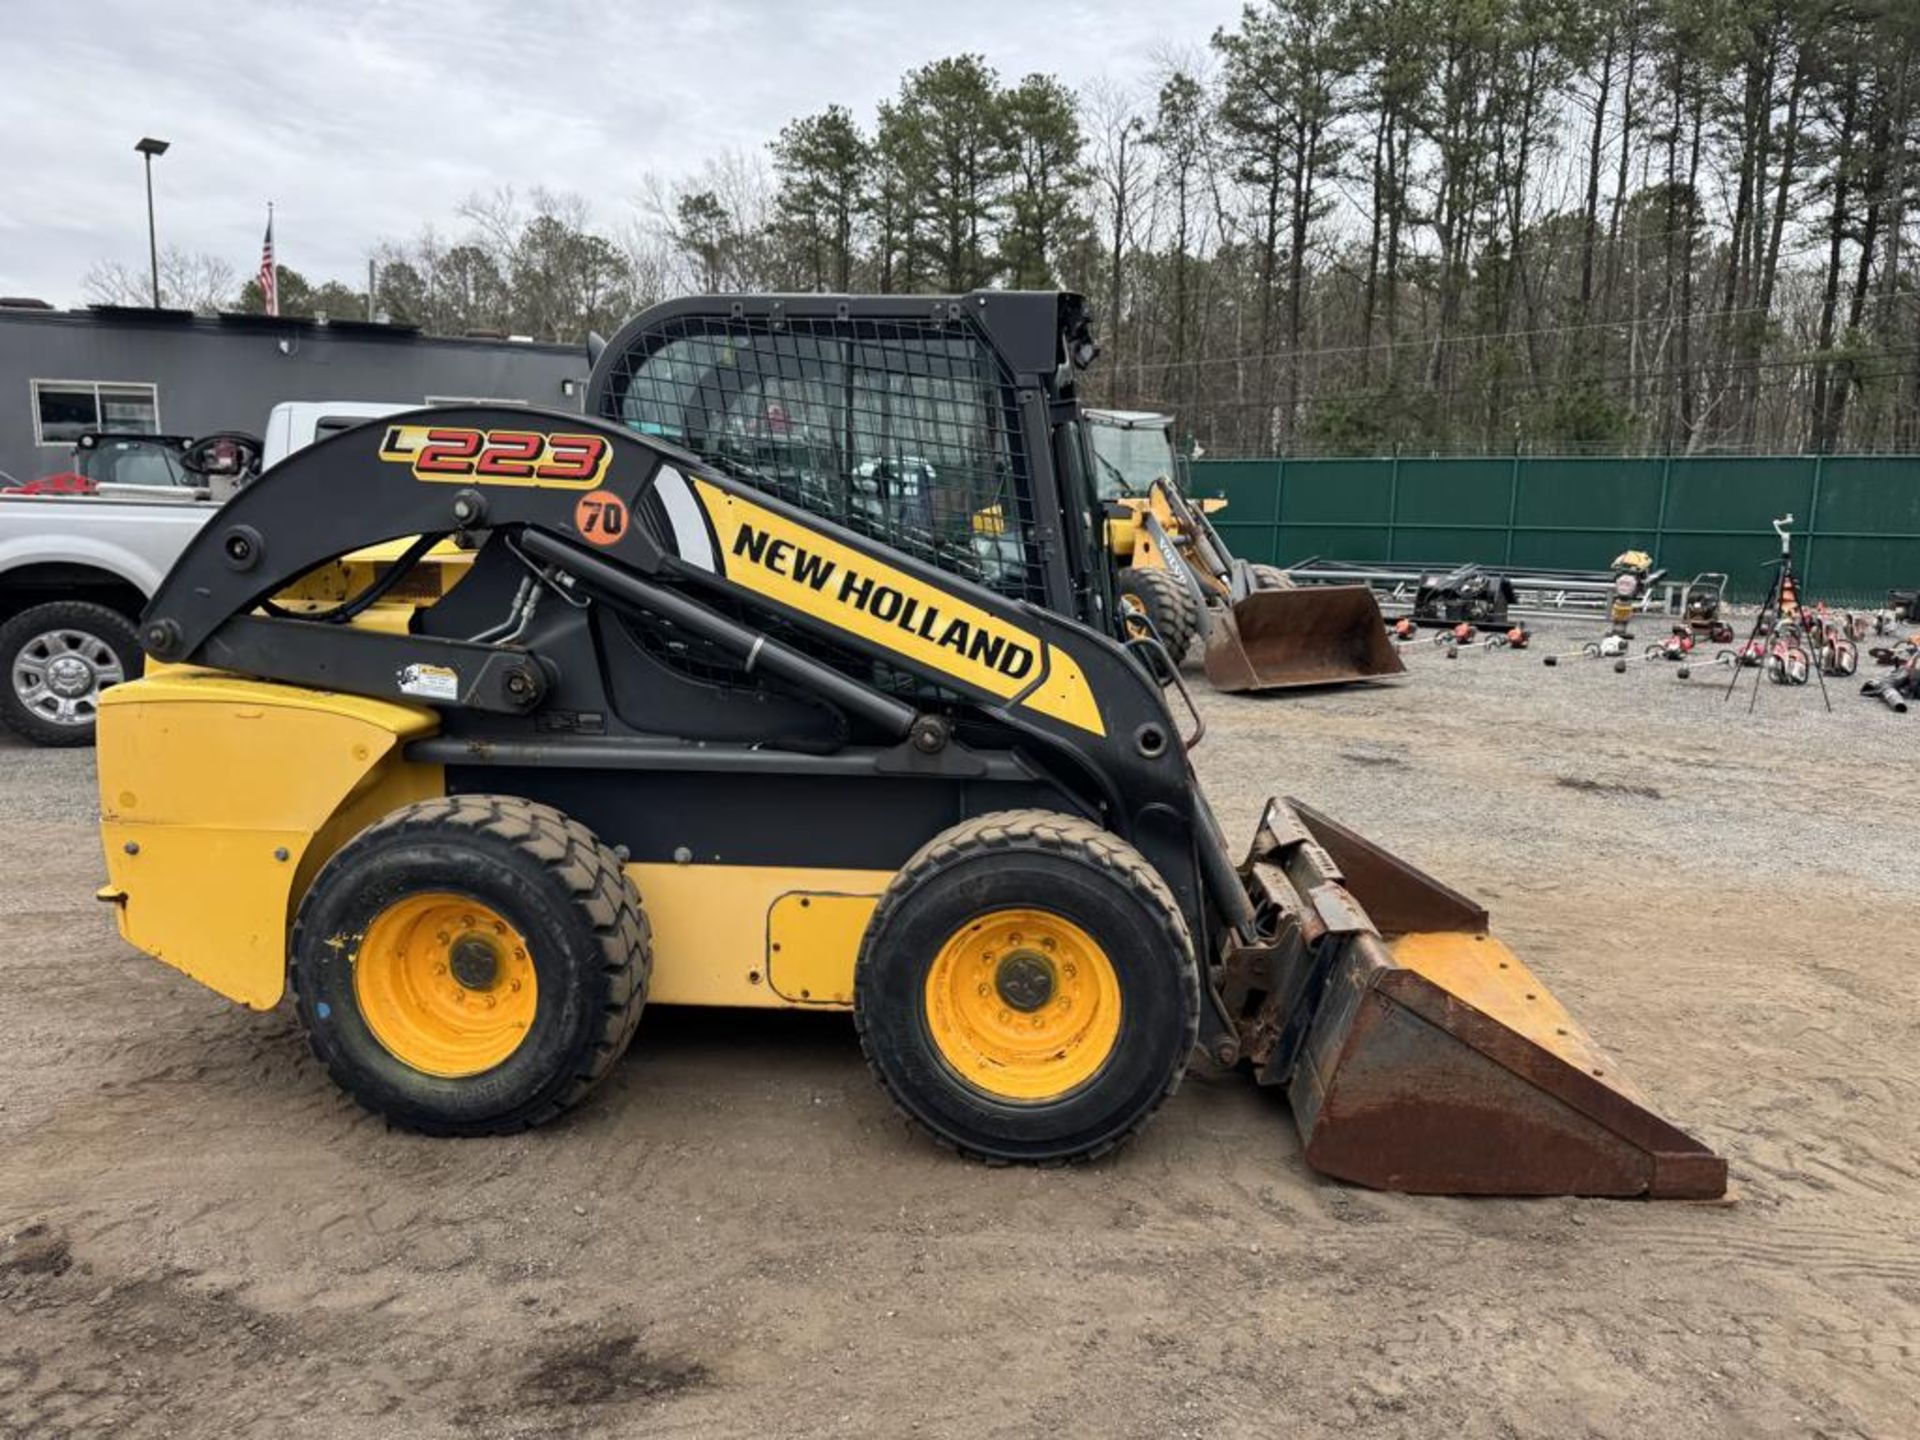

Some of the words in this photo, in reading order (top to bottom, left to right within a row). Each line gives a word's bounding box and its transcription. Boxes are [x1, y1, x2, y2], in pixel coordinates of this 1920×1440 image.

[582, 501, 622, 535] 70
[732, 523, 836, 592] NEW
[837, 570, 1034, 680] HOLLAND
